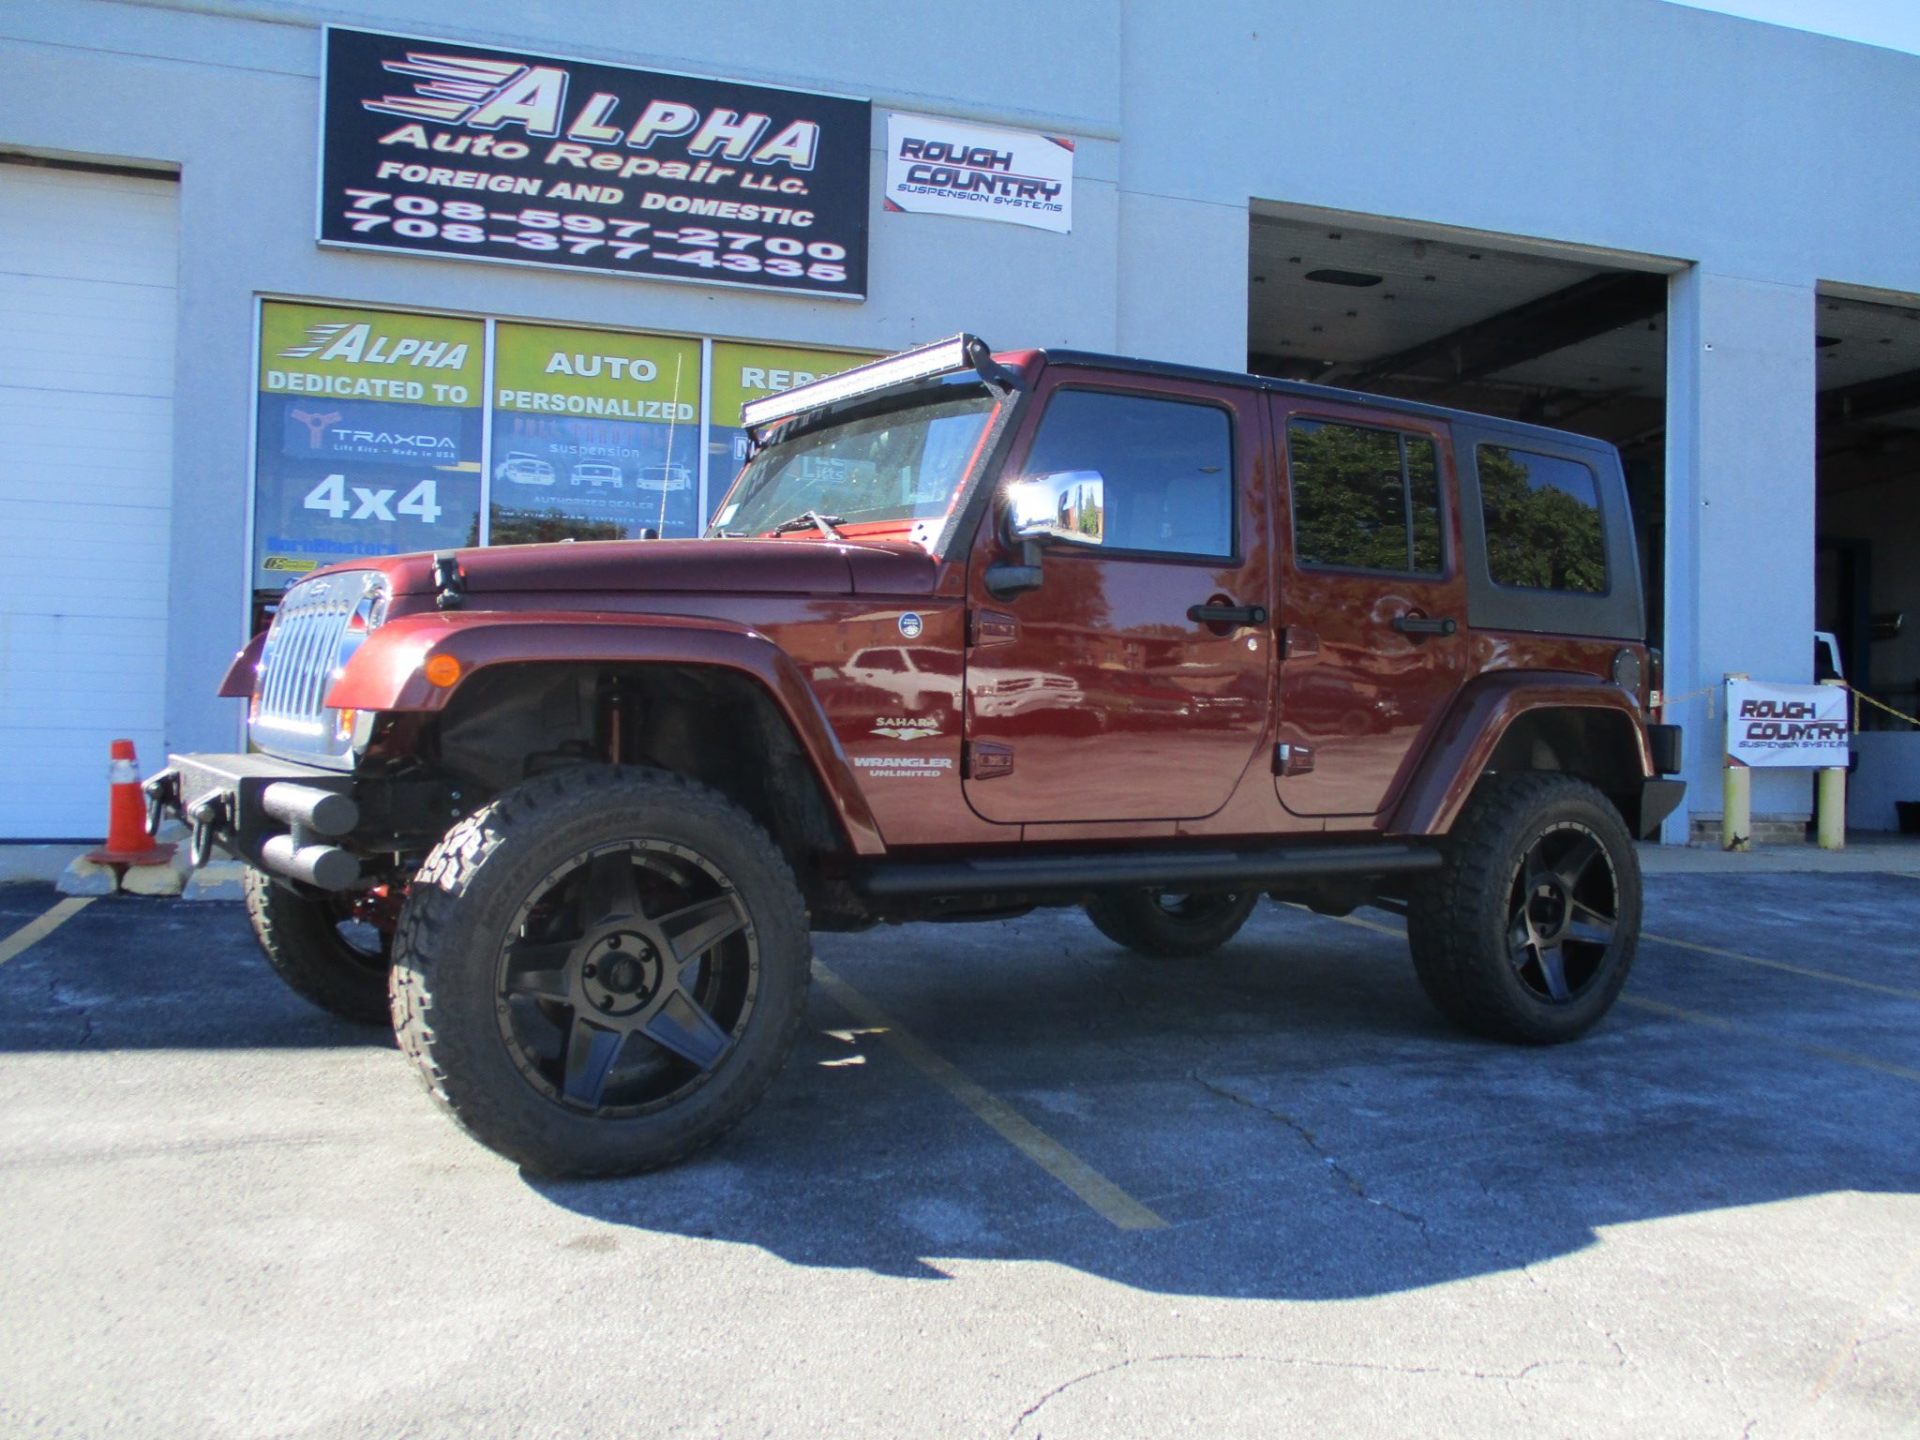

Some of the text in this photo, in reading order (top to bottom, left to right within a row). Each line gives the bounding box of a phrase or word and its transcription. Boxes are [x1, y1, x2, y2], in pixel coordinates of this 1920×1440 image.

[468, 66, 819, 170] ALPHA
[378, 125, 809, 195] Auto Repair LLC.
[900, 137, 1013, 172] ROUGH
[376, 162, 815, 227] FOREIGN AND DOMESTIC
[897, 183, 1062, 212] SUSPENSION SYSTEMS
[906, 164, 1062, 202] COUNTRY
[344, 189, 847, 262] 708-597-2700
[344, 212, 847, 282] 708-377-4335
[320, 323, 469, 371] ALPHA
[545, 352, 657, 382] AUTO
[742, 367, 831, 391] REP
[267, 371, 468, 404] DEDICATED TO
[500, 390, 693, 421] PERSONALIZED
[332, 429, 456, 449] TRAXDA
[549, 443, 641, 458] suspension
[304, 474, 442, 523] 4x4
[876, 717, 938, 727] SAHARA
[1740, 699, 1816, 719] ROUGH
[1746, 722, 1847, 740] COUNTRY
[854, 757, 952, 768] WRANGLER
[869, 769, 941, 777] UNLIMITED
